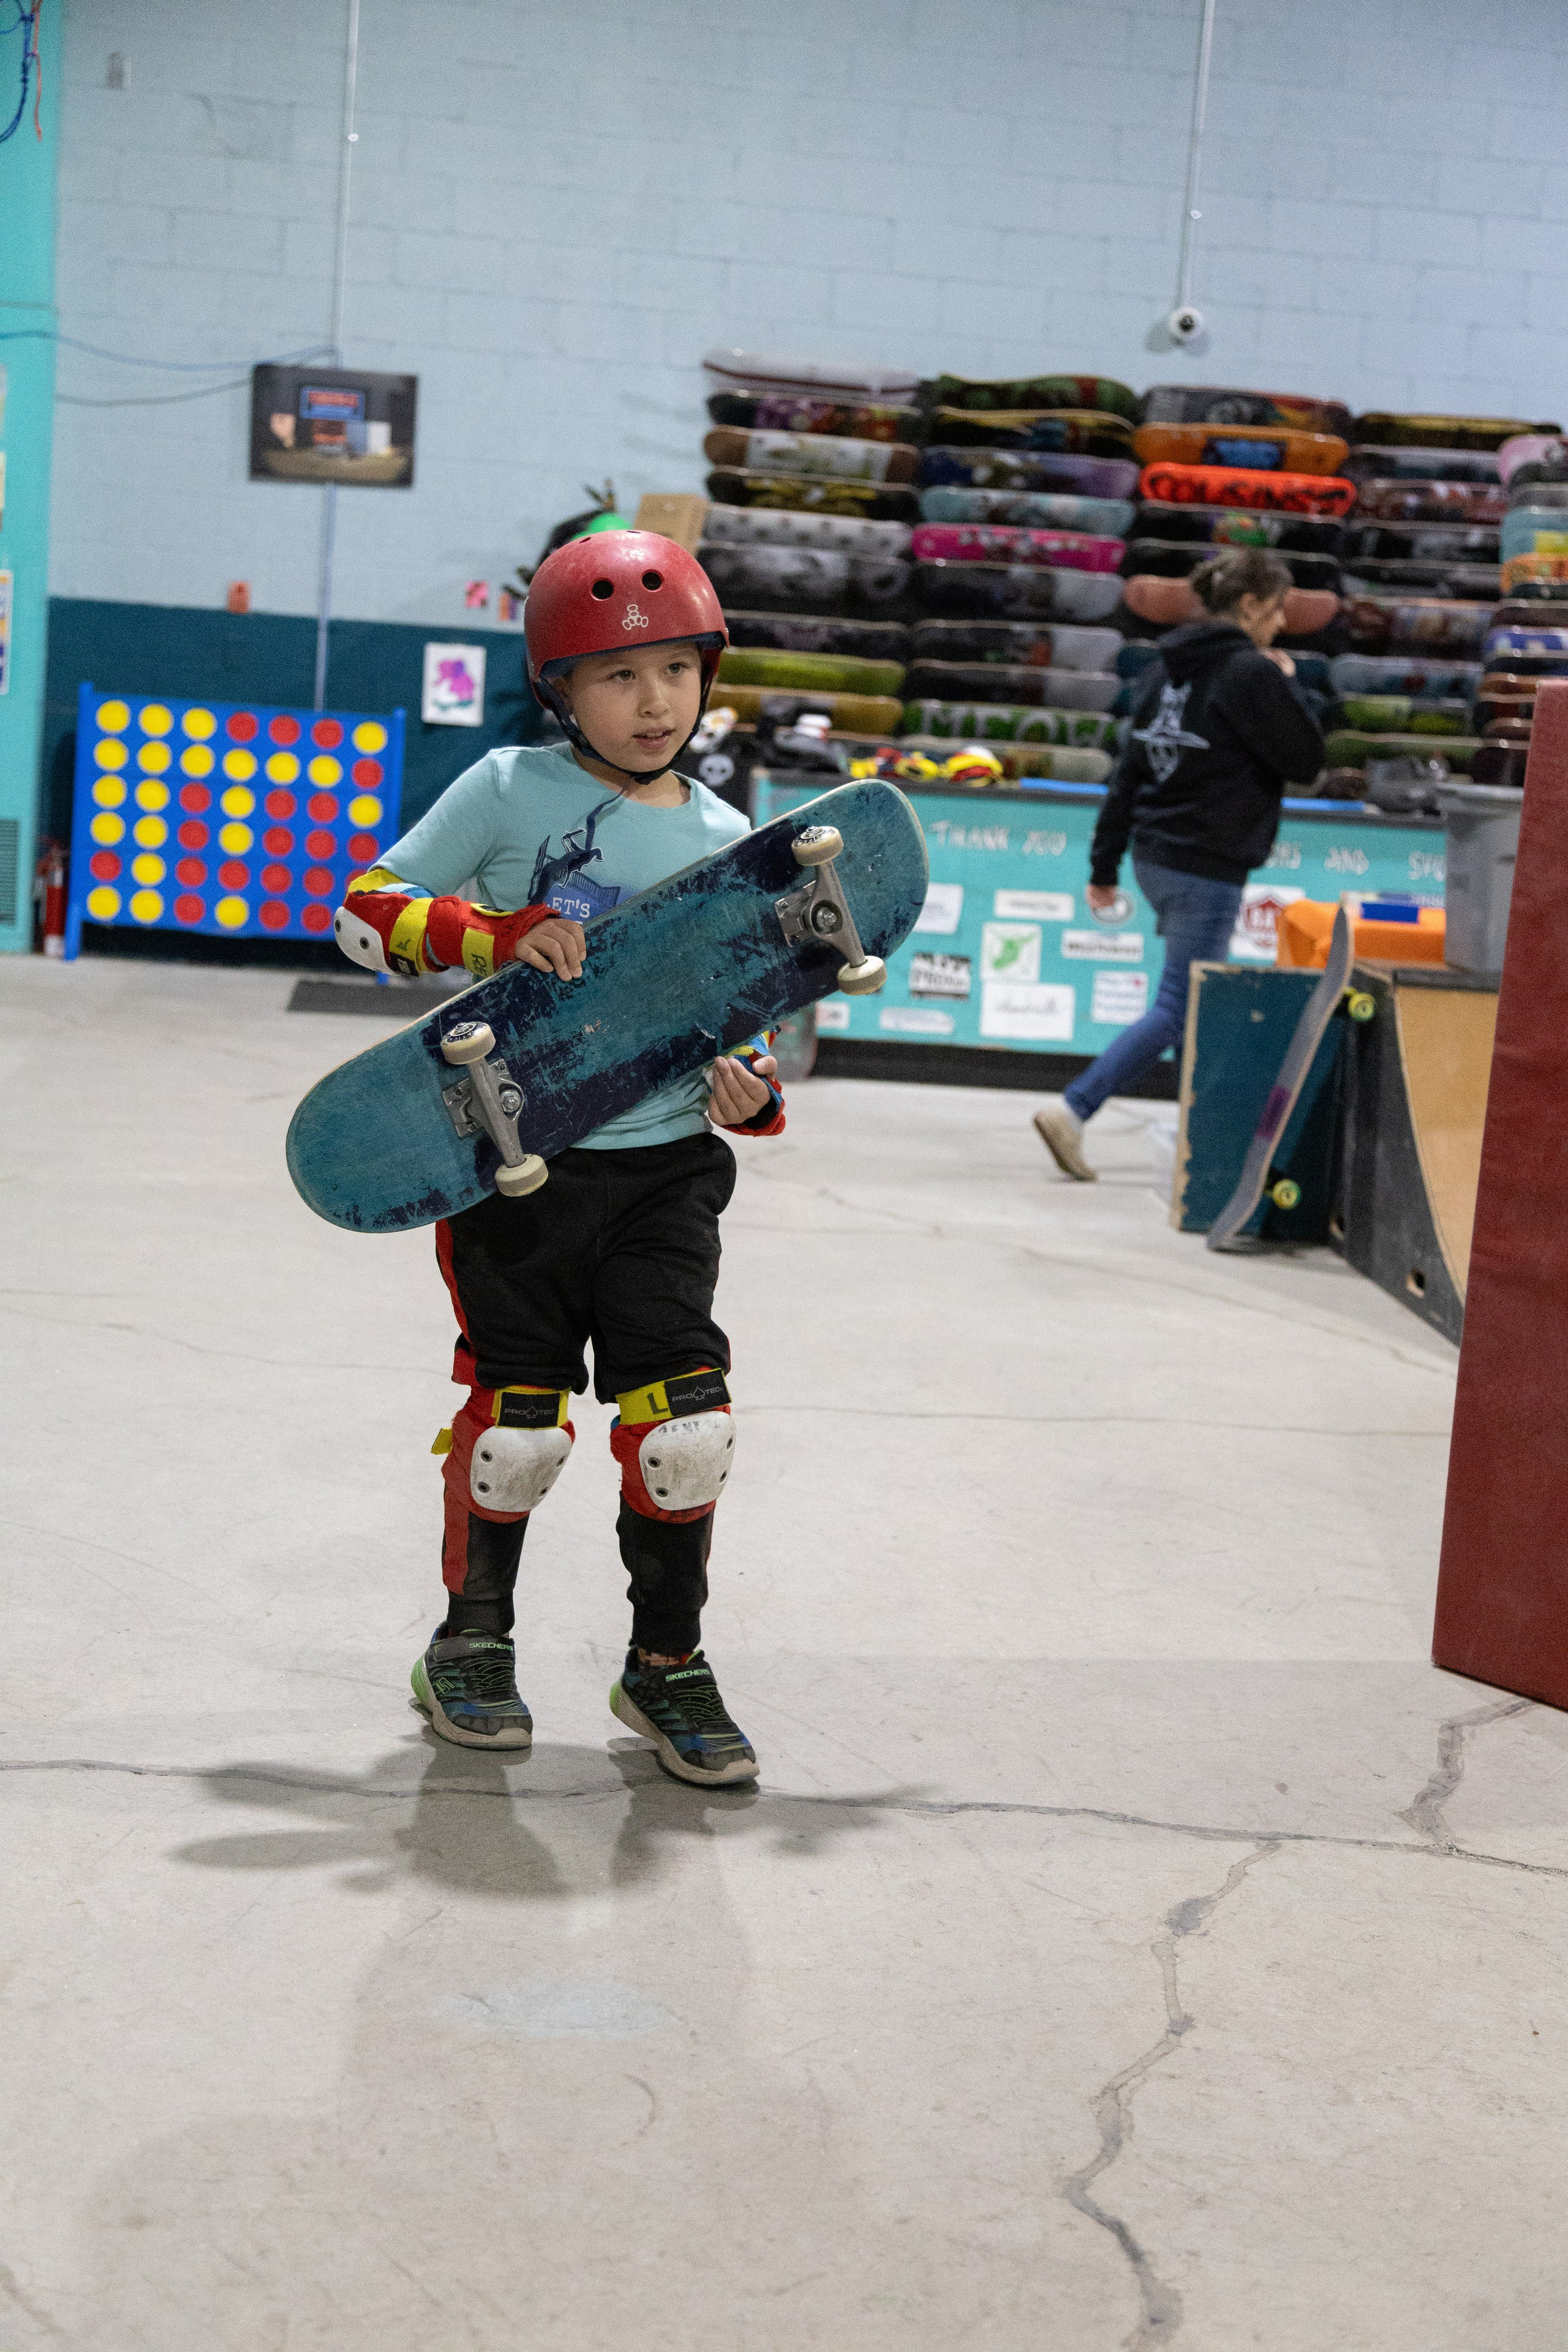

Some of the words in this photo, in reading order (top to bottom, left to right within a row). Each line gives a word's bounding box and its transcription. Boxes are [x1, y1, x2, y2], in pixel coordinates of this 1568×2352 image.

[929, 820, 1011, 851] THANK
[547, 897, 590, 918] ET'S
[647, 1392, 669, 1415] L
[671, 1393, 694, 1403] PRO
[704, 1387, 721, 1395] TEC
[468, 1642, 514, 1651] SKECHERS
[665, 1668, 710, 1683] SKECHERS
